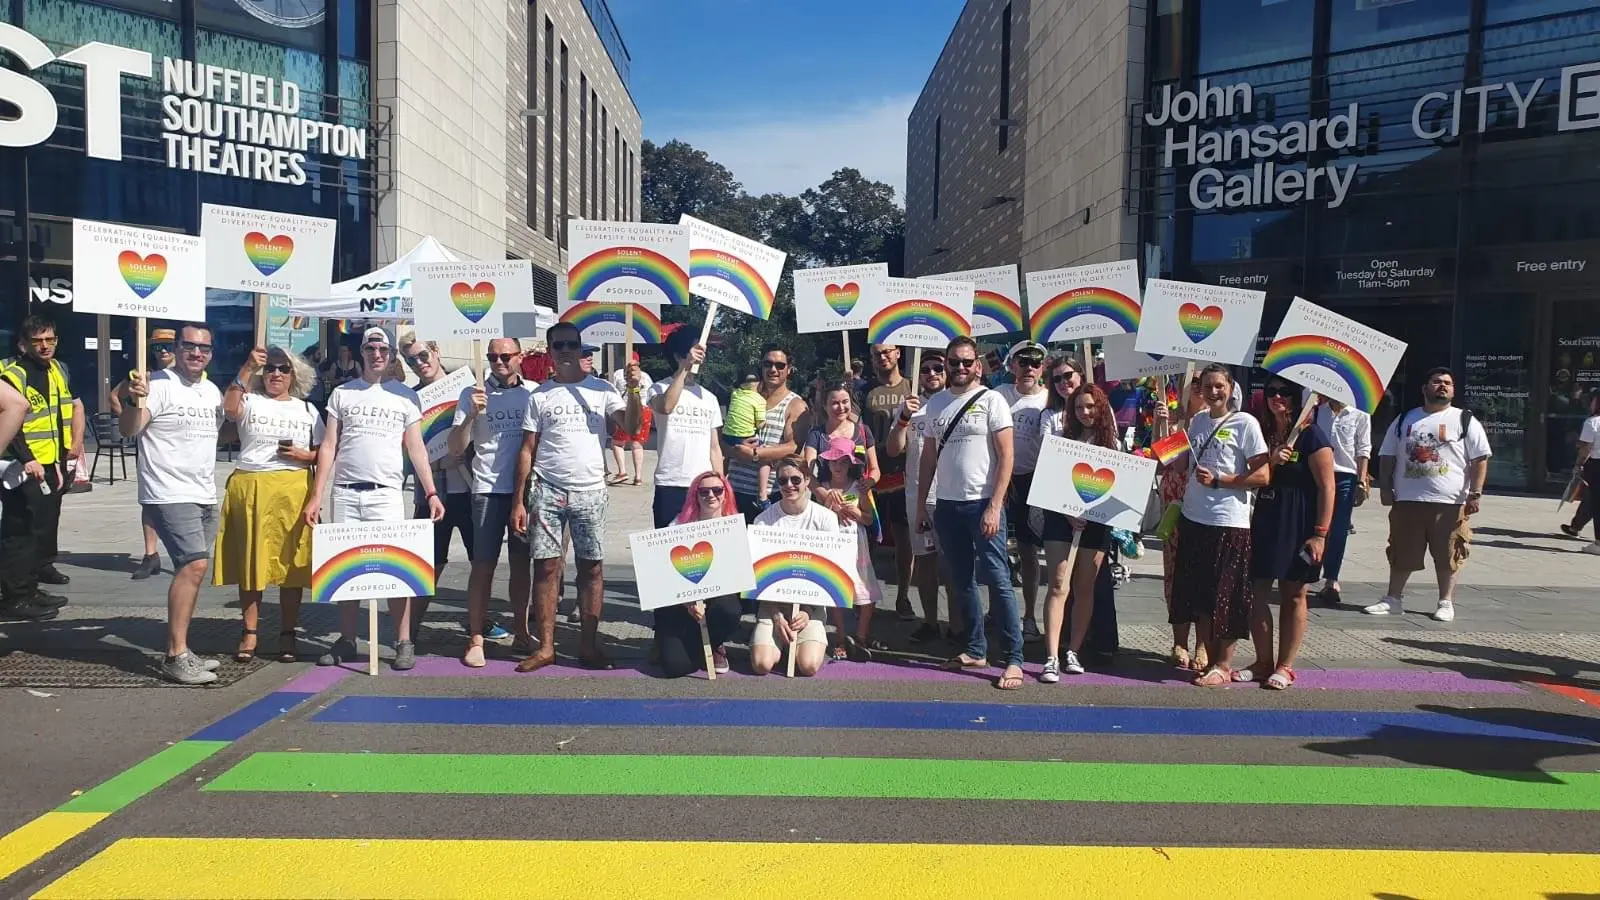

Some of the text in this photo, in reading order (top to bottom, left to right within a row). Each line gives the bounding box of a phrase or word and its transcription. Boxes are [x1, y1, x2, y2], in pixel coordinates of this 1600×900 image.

[163, 56, 299, 115] NUFFIELD
[1145, 78, 1252, 126] John
[1411, 77, 1545, 140] CITY
[162, 95, 366, 160] SOUTHAMPTON
[1164, 102, 1359, 168] Hansard
[162, 132, 306, 186] THEATRES
[1189, 161, 1359, 209] Gallery
[1371, 259, 1398, 270] Open
[1517, 259, 1586, 273] Free entry
[1219, 274, 1268, 286] Free entry
[1336, 267, 1436, 281] Tuesday to Saturday
[29, 276, 73, 304] NS
[241, 280, 291, 290] #SOPROUD
[356, 278, 412, 292] NST
[118, 303, 167, 313] #SOPROUD
[359, 296, 401, 312] NST
[1065, 323, 1107, 332] #SOPROUD
[871, 394, 905, 406] ADIDA
[350, 584, 396, 592] #SOPROUD
[676, 586, 721, 598] #SOPROUD
